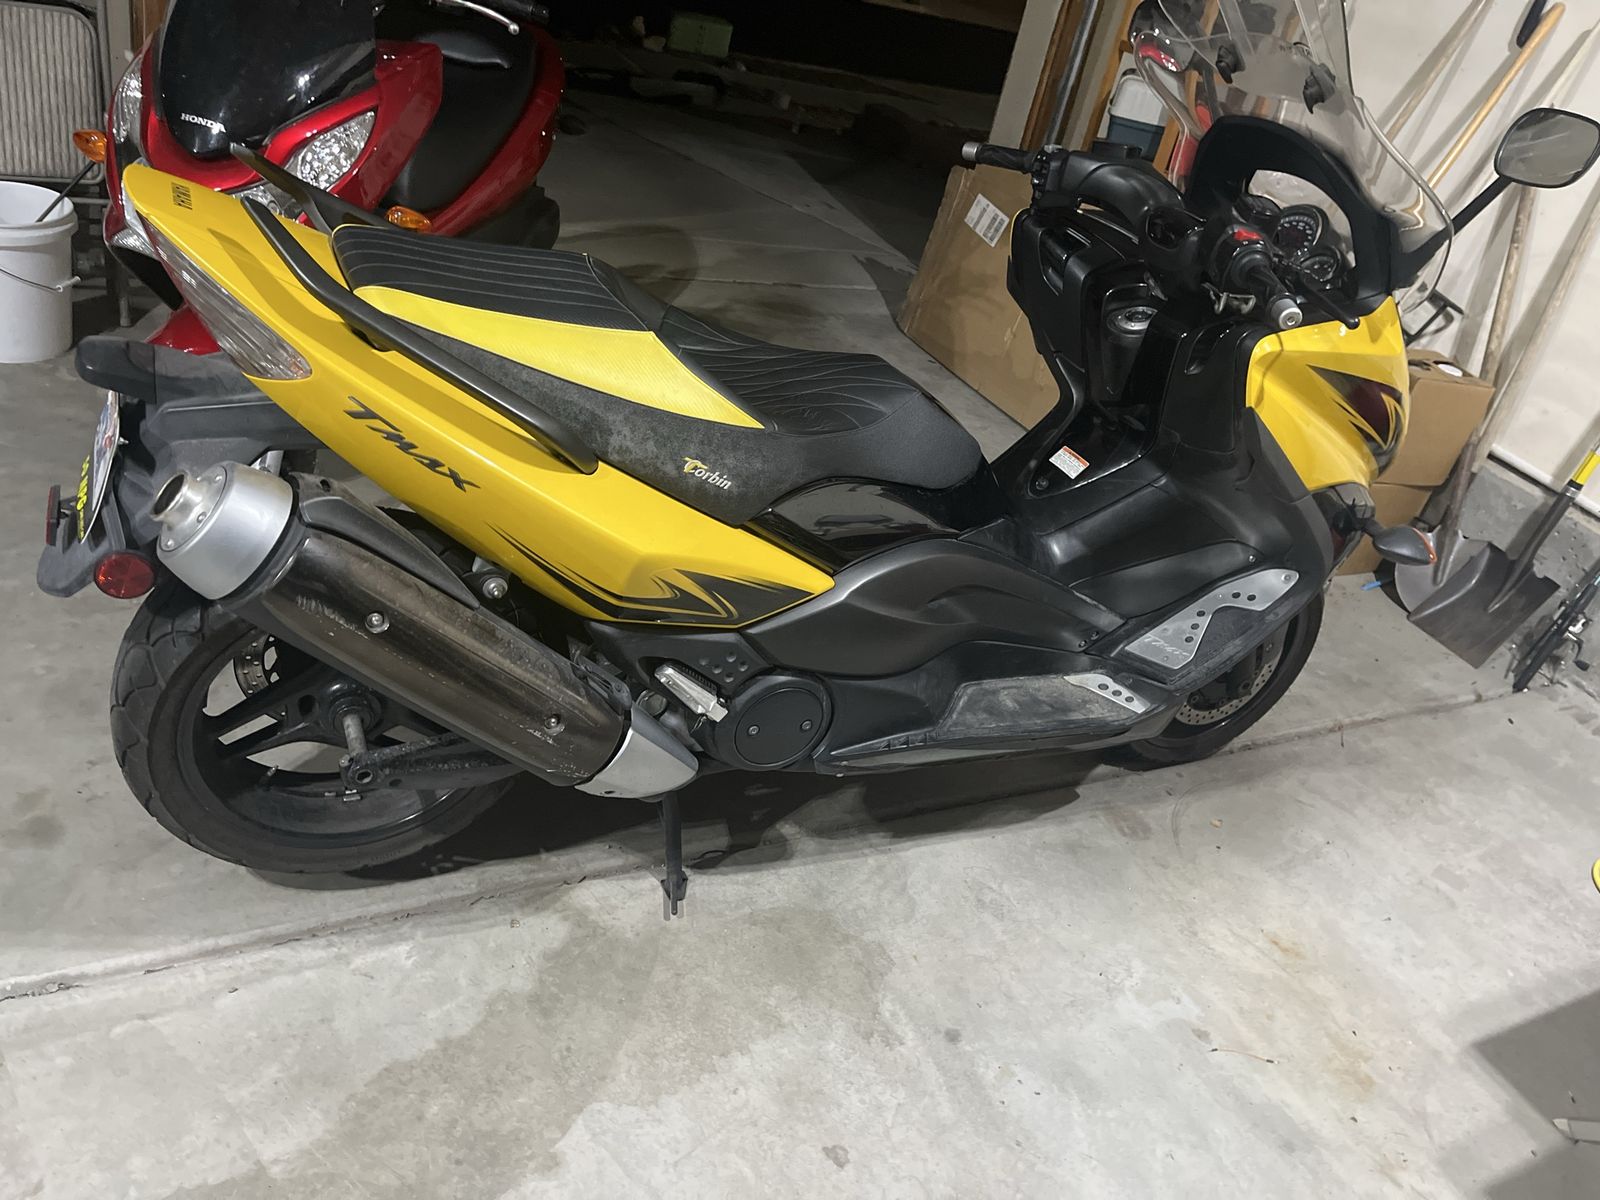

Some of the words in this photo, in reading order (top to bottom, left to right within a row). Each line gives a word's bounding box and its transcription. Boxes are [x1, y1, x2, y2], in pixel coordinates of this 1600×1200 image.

[181, 113, 226, 133] HONDA
[343, 396, 481, 493] TMAX
[683, 457, 732, 490] Corbin
